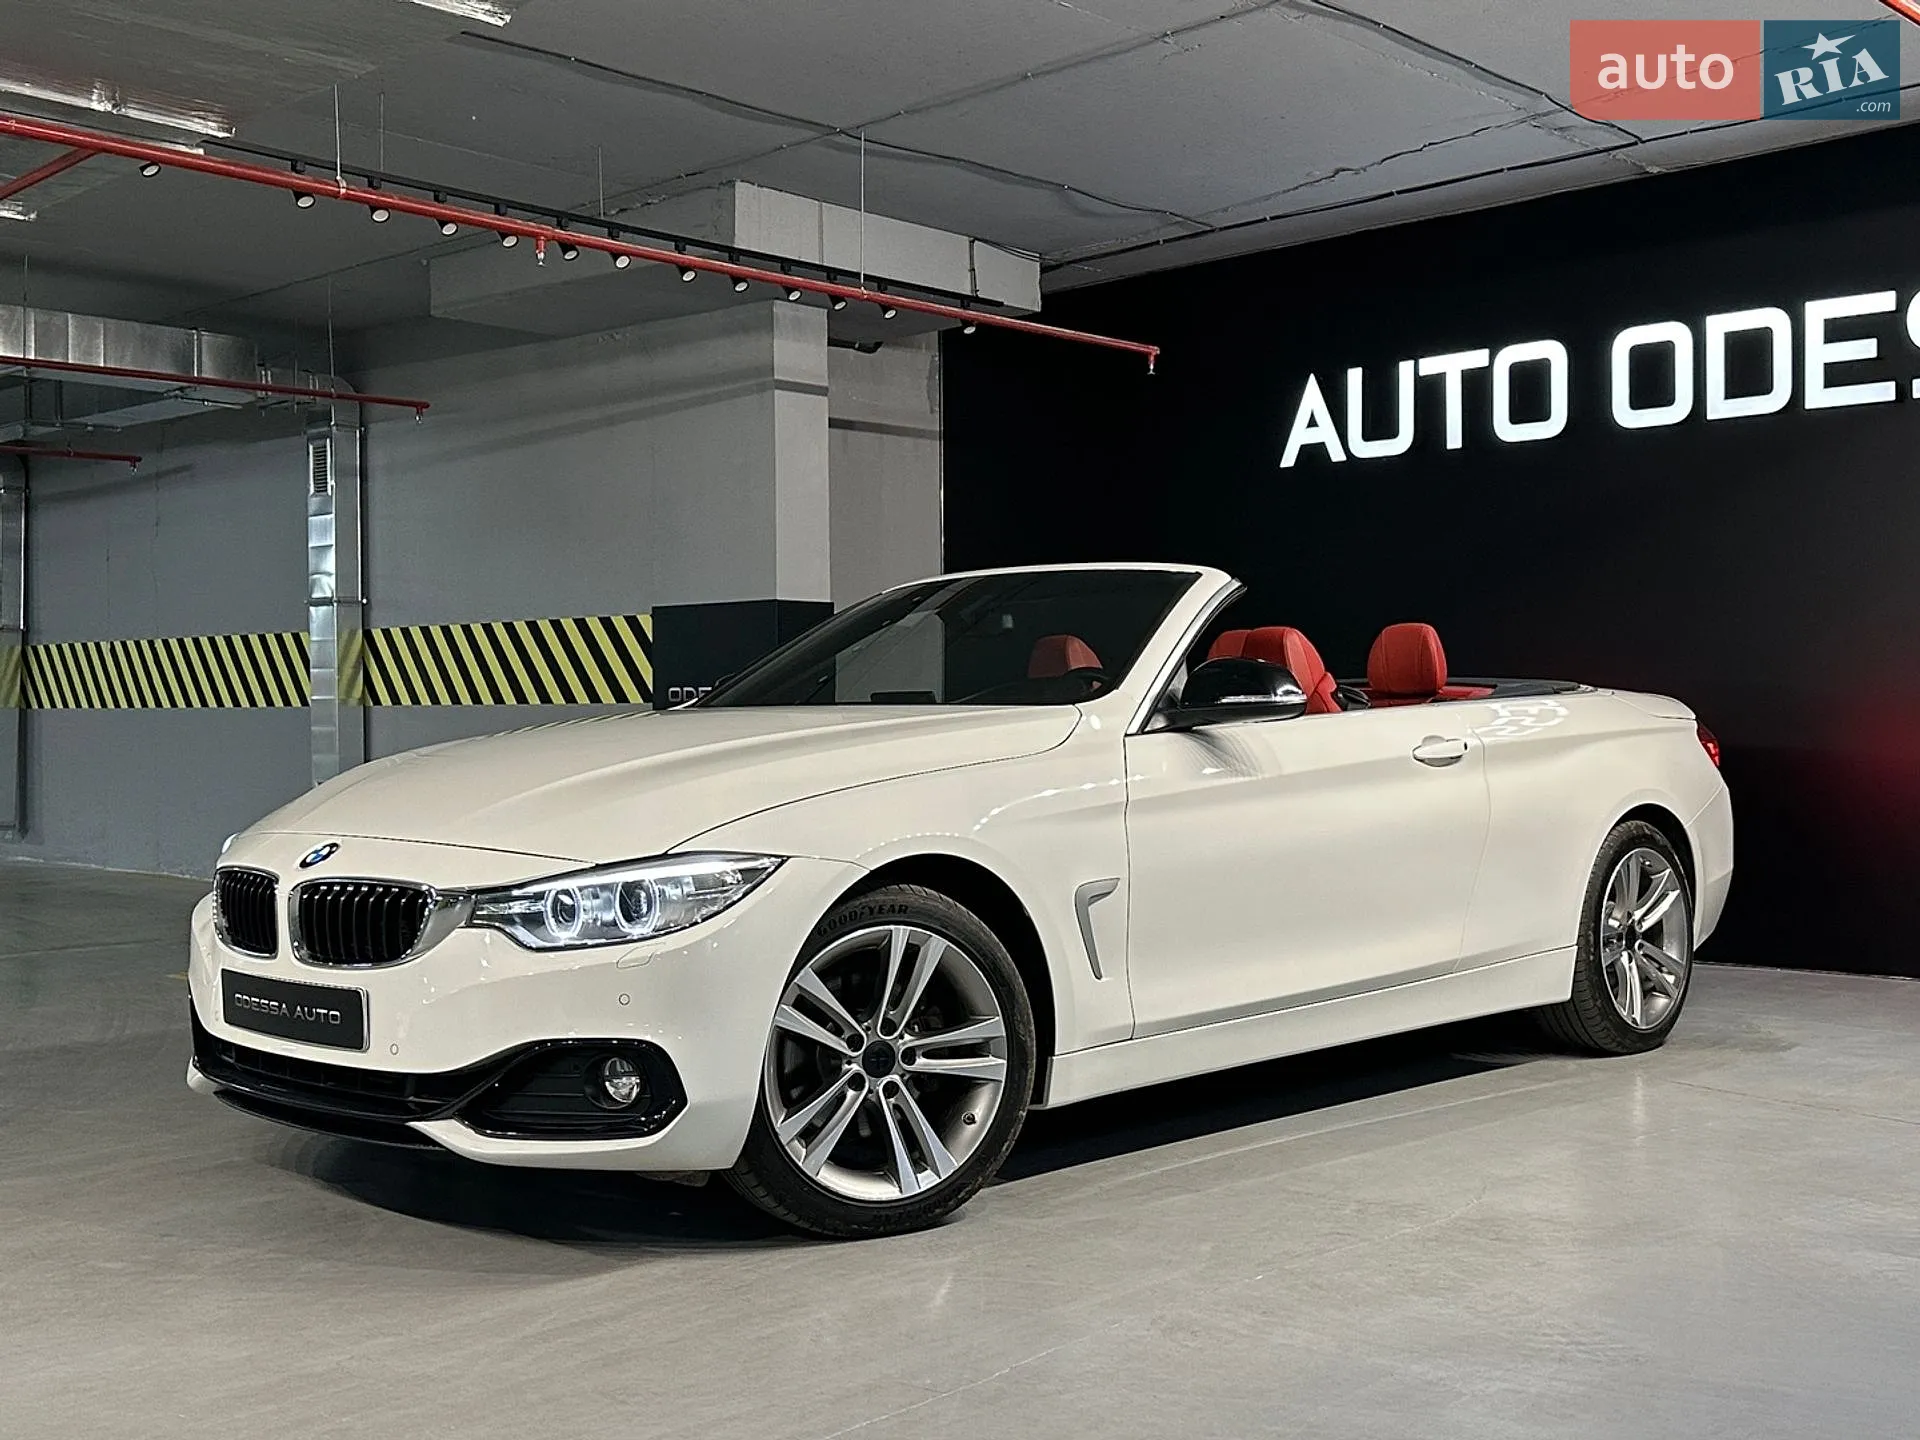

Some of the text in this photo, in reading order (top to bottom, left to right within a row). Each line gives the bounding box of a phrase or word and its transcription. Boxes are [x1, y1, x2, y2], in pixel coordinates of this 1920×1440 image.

[1280, 290, 1920, 468] AUTO ODE
[816, 903, 910, 937] GOODYEAR
[234, 993, 341, 1025] ODESSA AUTO
